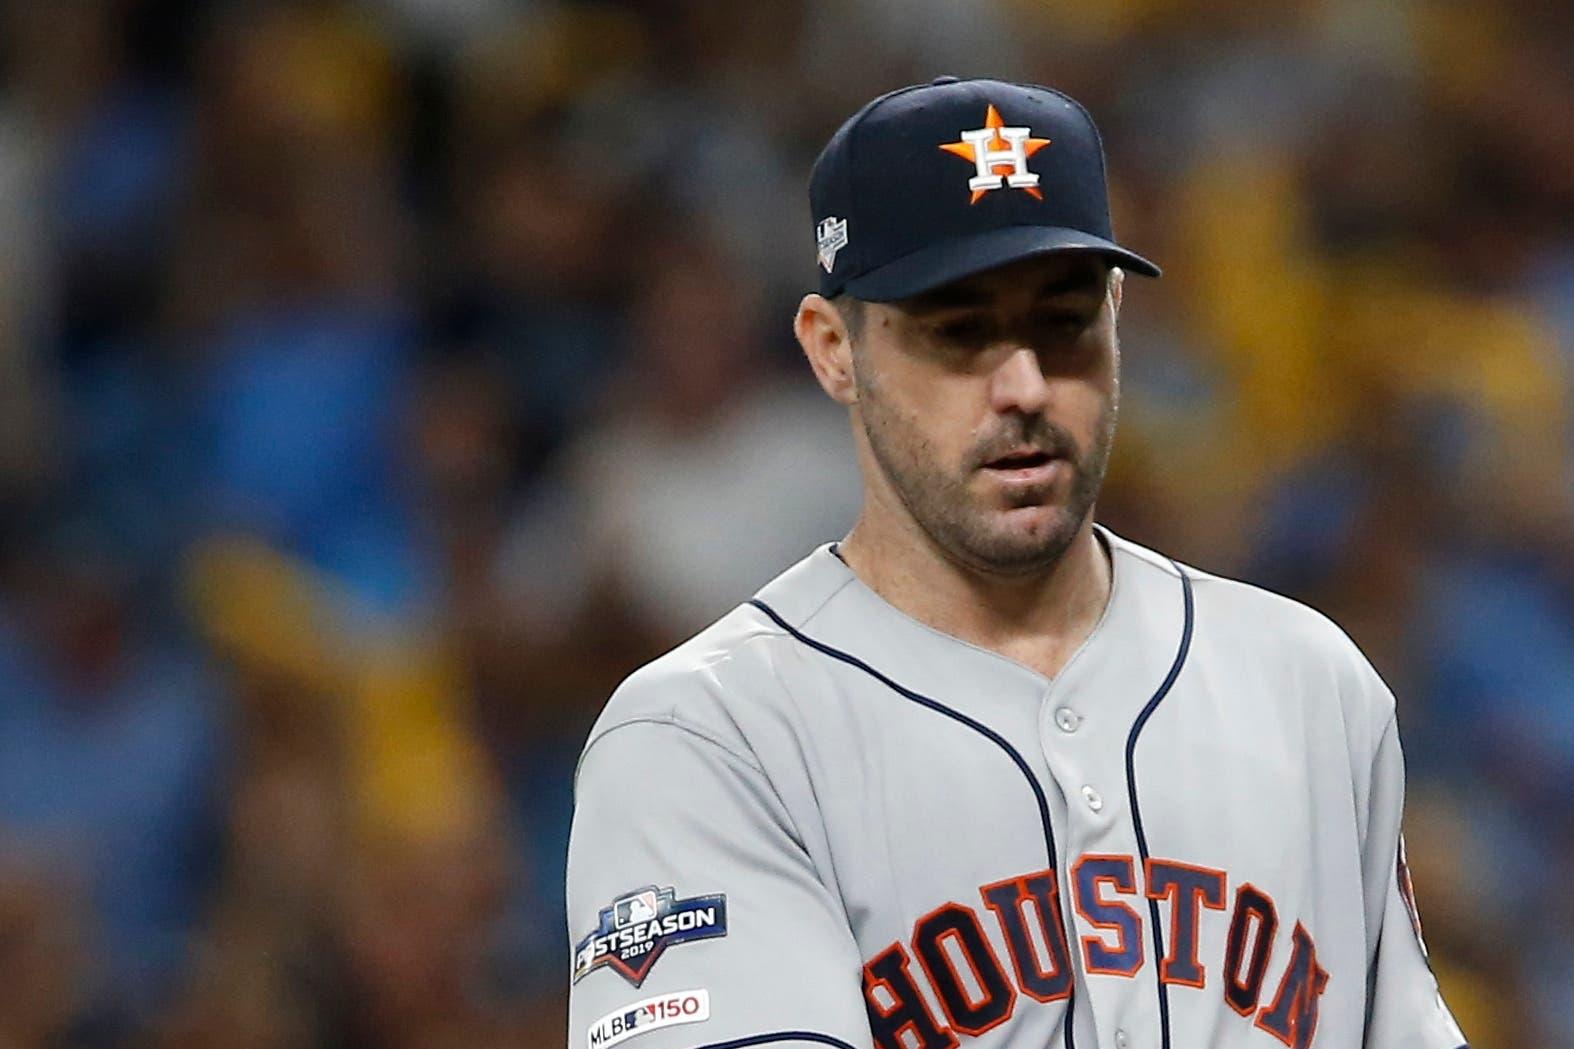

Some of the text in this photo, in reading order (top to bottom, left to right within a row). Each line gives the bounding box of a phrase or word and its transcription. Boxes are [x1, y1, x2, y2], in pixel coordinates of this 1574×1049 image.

[961, 126, 1041, 191] H
[620, 941, 654, 961] 2019
[656, 996, 700, 1020] 150
